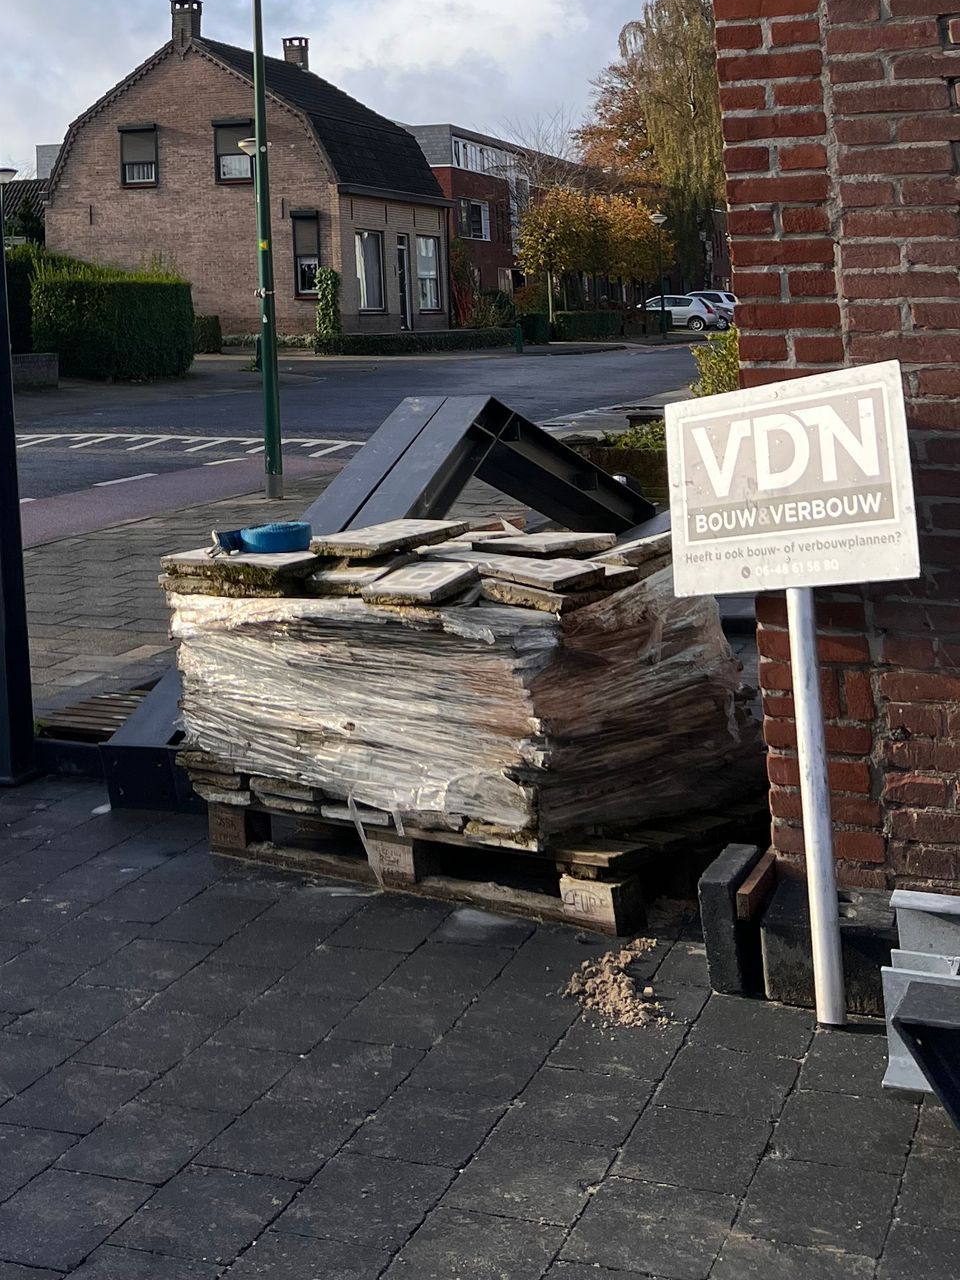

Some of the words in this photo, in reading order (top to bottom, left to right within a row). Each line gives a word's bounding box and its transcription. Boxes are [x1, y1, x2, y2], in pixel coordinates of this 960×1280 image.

[691, 397, 880, 497] VDN
[685, 552, 713, 564] Heeft
[715, 552, 722, 561] u
[725, 548, 744, 560] ook
[747, 545, 781, 557] bouw-
[784, 541, 796, 554] of
[798, 531, 902, 552] verbouwplannen?
